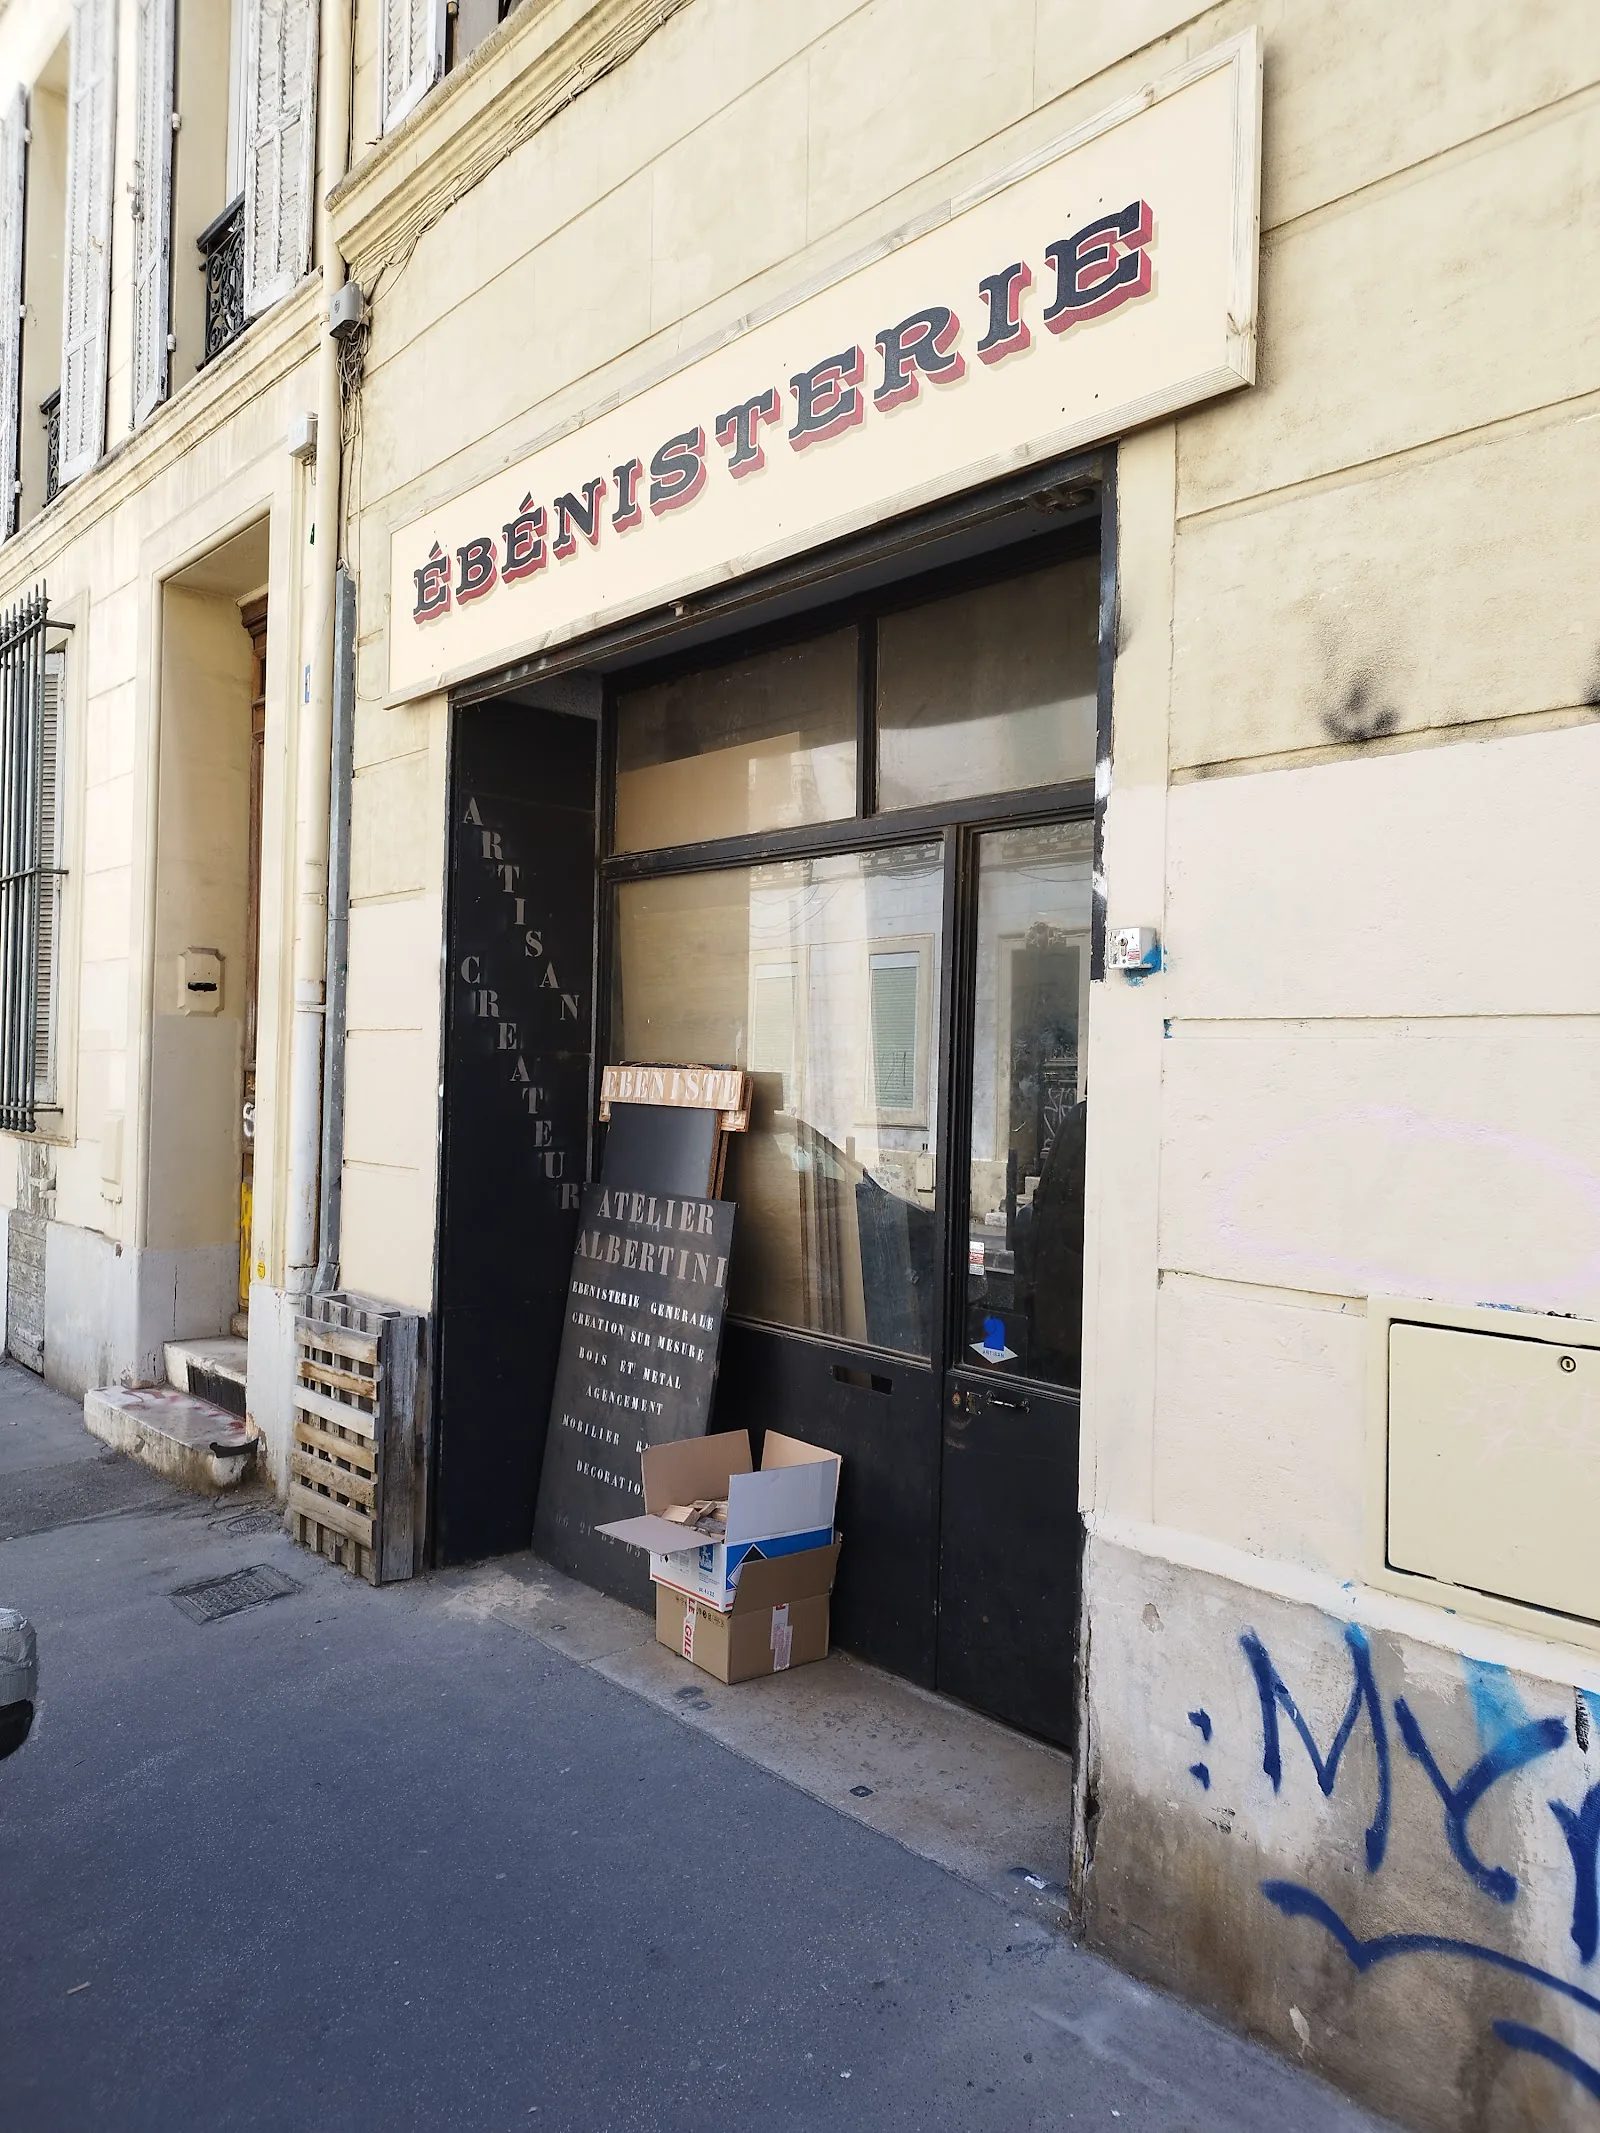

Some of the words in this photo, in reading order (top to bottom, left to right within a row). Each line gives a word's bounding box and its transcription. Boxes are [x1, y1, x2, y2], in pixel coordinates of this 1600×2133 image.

[412, 198, 1153, 625] ÉBÉNISTERIE
[462, 797, 580, 1021] ARTISAN
[461, 956, 580, 1210] CREATEUR
[604, 1070, 738, 1105] EBENISTE
[597, 1190, 715, 1235] ATELIER
[574, 1229, 727, 1288] ALBERTINI
[572, 1281, 641, 1308] EBENISTERIE
[650, 1302, 715, 1331] GENERALE
[572, 1312, 625, 1336] CREATION
[630, 1330, 650, 1347] SUR
[657, 1336, 705, 1362] MESURE
[578, 1347, 608, 1367] BOIS
[619, 1360, 634, 1375] ET
[642, 1367, 682, 1390] METAL
[585, 1386, 664, 1416] AGENCEMENT
[561, 1413, 620, 1446] MOBILIER
[576, 1459, 645, 1498] DECORATIO
